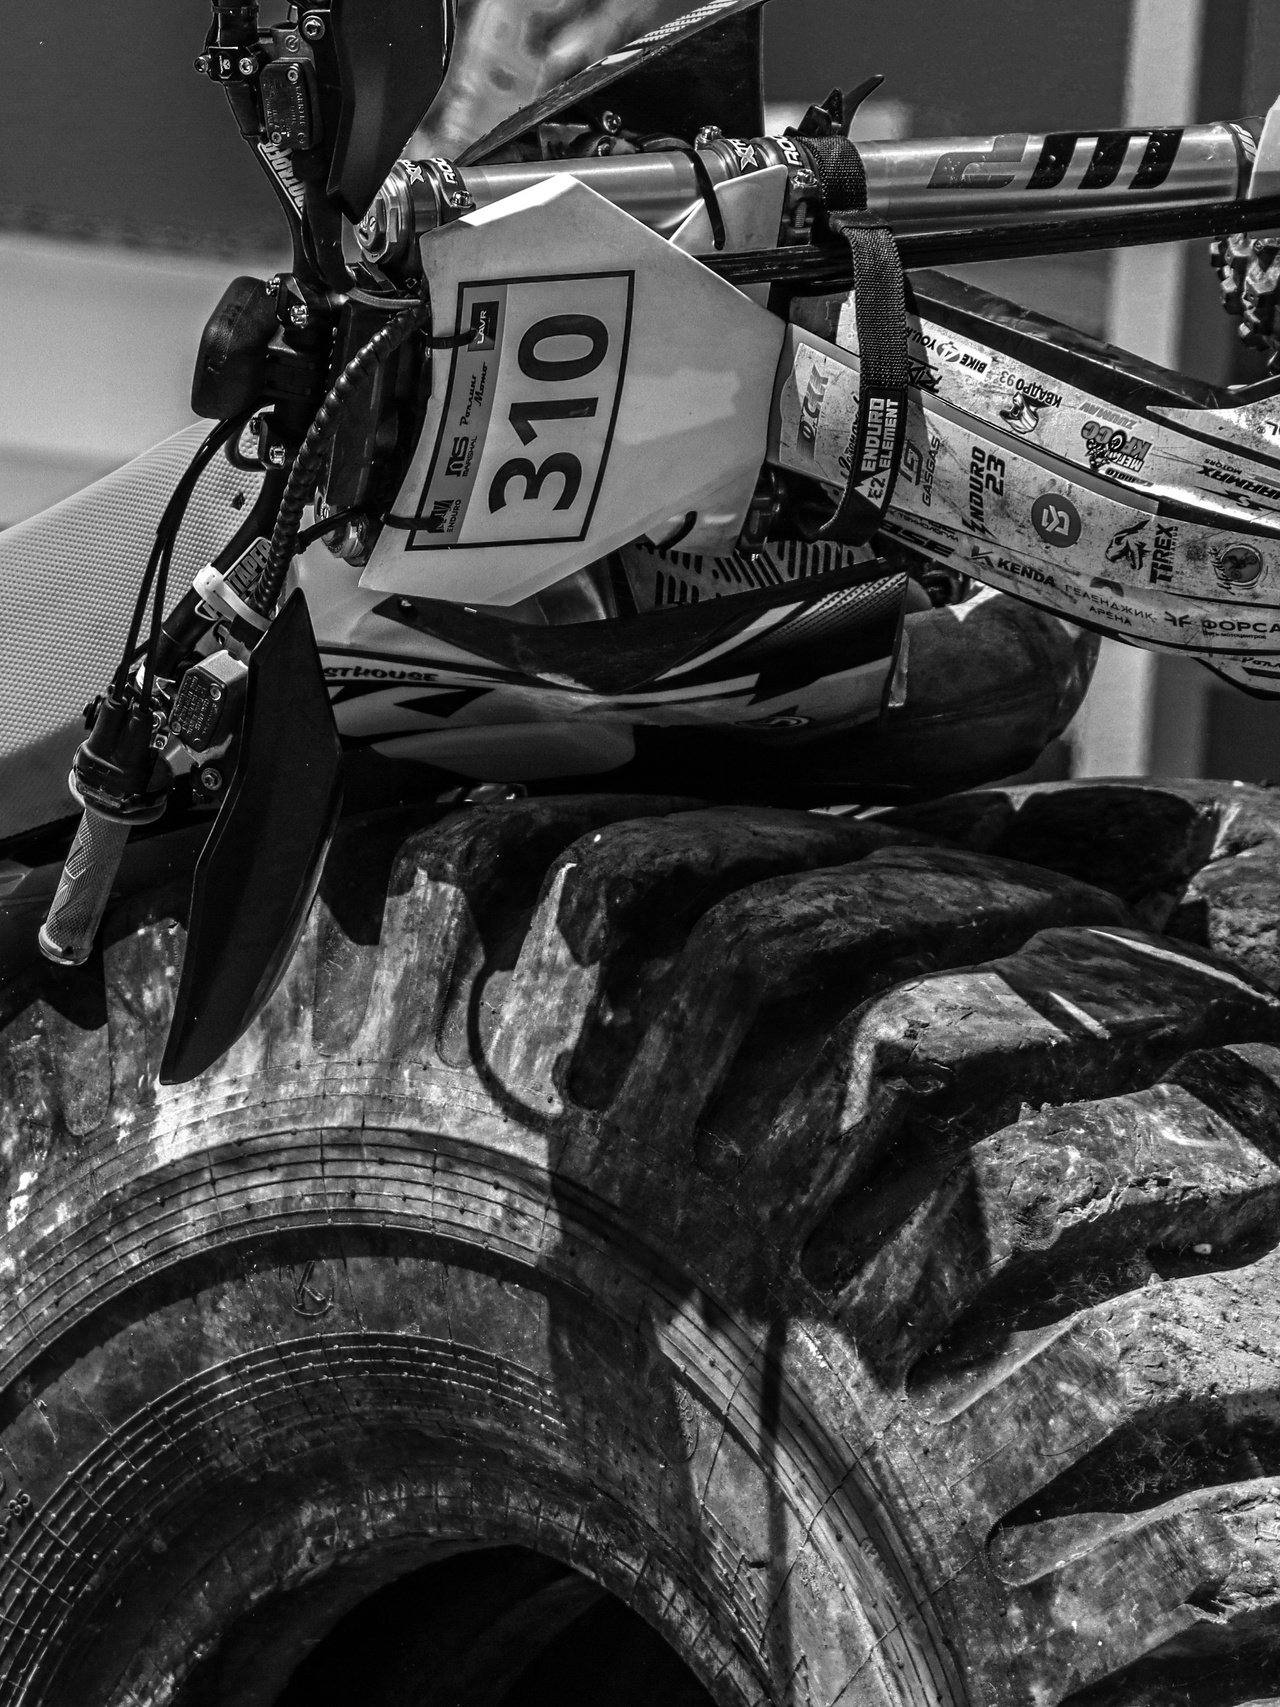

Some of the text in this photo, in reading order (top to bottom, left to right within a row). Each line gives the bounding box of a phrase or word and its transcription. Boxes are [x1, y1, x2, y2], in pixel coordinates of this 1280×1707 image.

[476, 309, 487, 345] LAVR
[959, 353, 988, 374] BIKE
[999, 370, 1063, 408] КВАДРО 93
[488, 313, 609, 514] 310
[861, 398, 885, 472] ENDURO
[879, 398, 899, 468] ELEMENT
[462, 435, 477, 478] MARSHAL
[923, 436, 940, 507] GASGAS
[985, 454, 1006, 497] 23
[1205, 458, 1243, 475] MOTORS
[446, 499, 461, 533] ENDURO
[1150, 523, 1174, 584] TIREX
[998, 558, 1056, 588] KENDA
[1065, 584, 1154, 621] ГЕЛЕНДЖИК
[1089, 605, 1133, 627] АРЕНА
